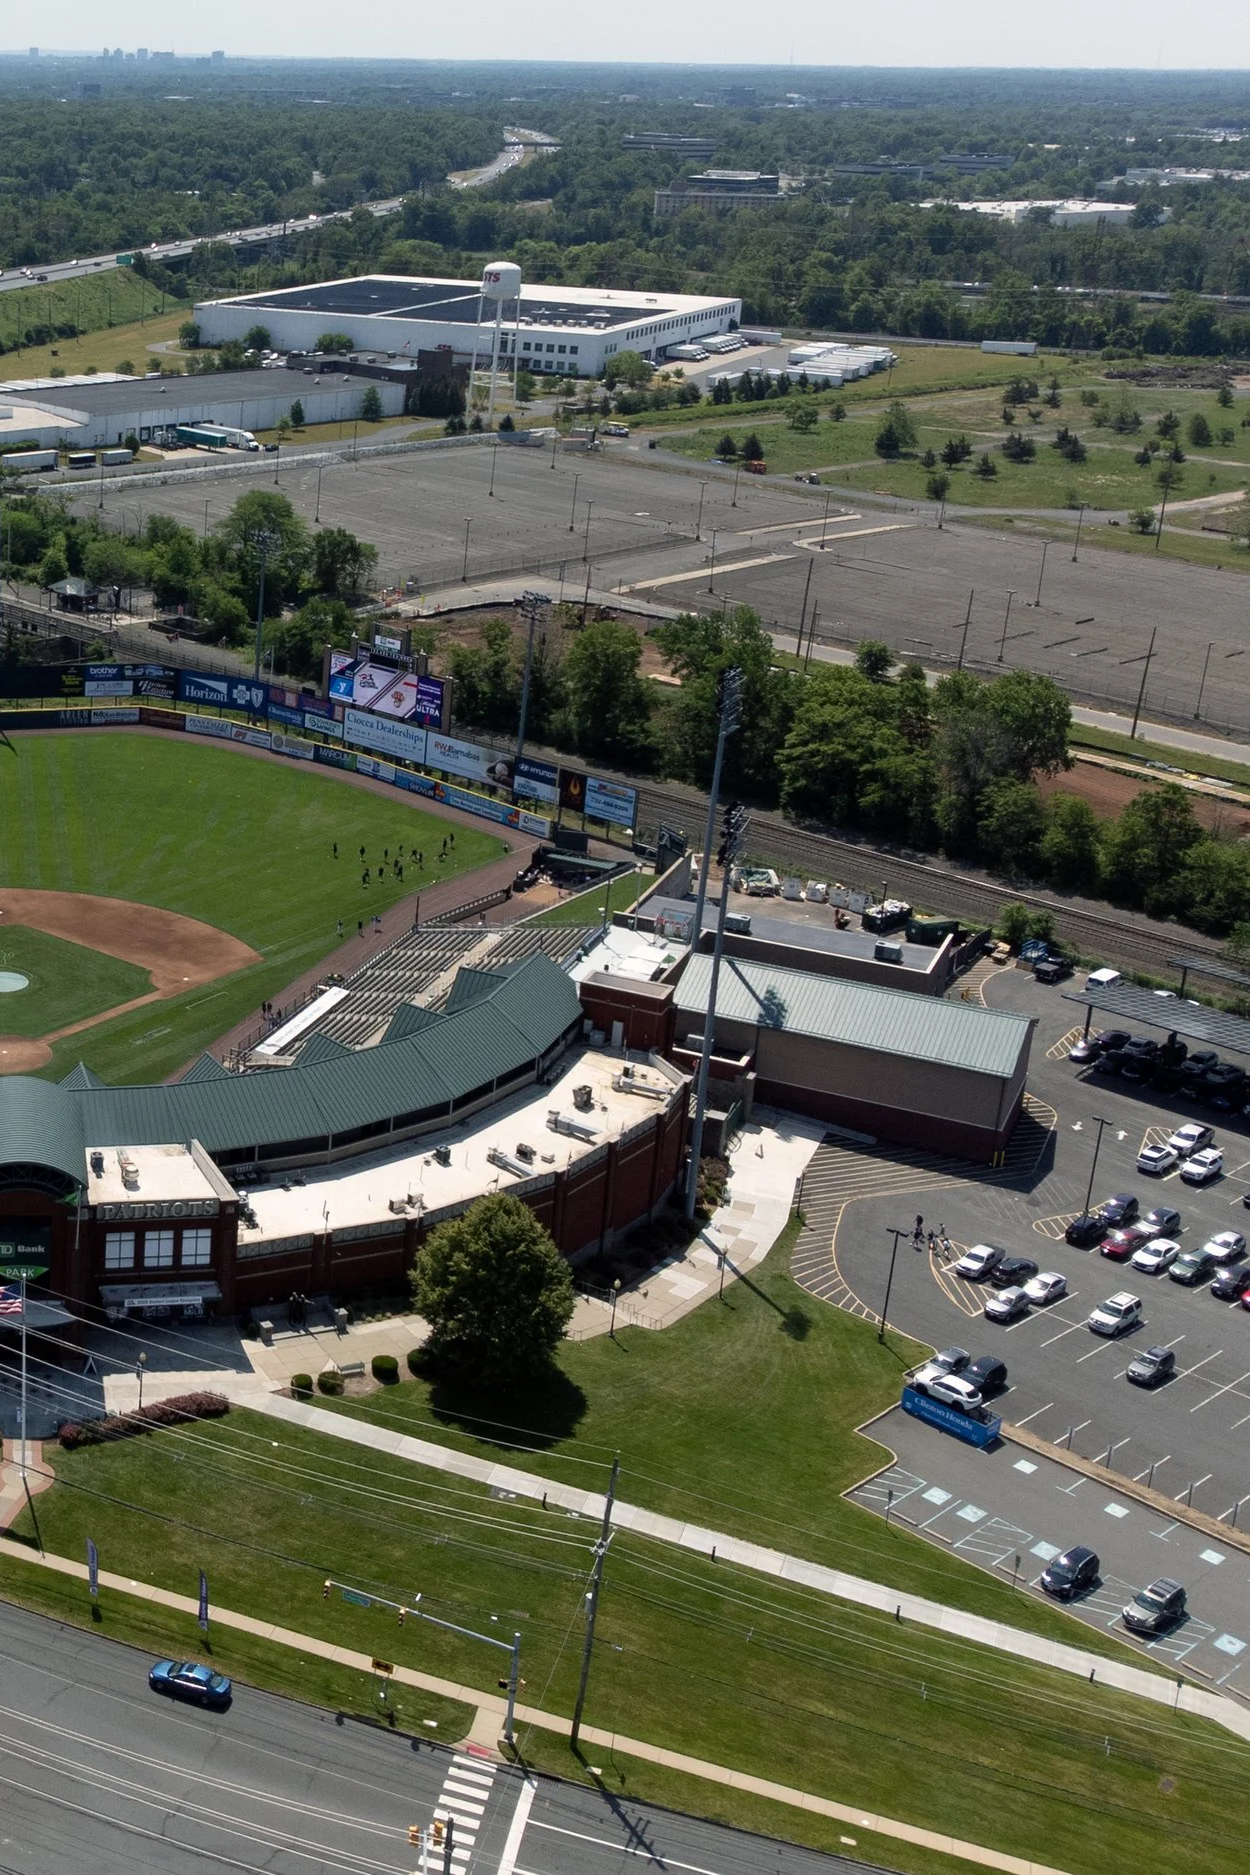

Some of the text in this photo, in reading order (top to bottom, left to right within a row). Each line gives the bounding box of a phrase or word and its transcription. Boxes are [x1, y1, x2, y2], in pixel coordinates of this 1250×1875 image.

[90, 667, 118, 675] brother
[185, 685, 228, 702] Horizon
[416, 705, 440, 717] ULTRA
[347, 712, 374, 729] Ciocca
[376, 721, 423, 744] Dealerships
[319, 747, 350, 760] MARCUM
[530, 768, 558, 779] HYUNDA
[103, 1200, 214, 1219] PATRIOTS
[17, 1244, 45, 1253] Bank
[6, 1268, 34, 1277] PARK
[914, 1397, 946, 1416] Clinton
[946, 1411, 973, 1430] Honda
